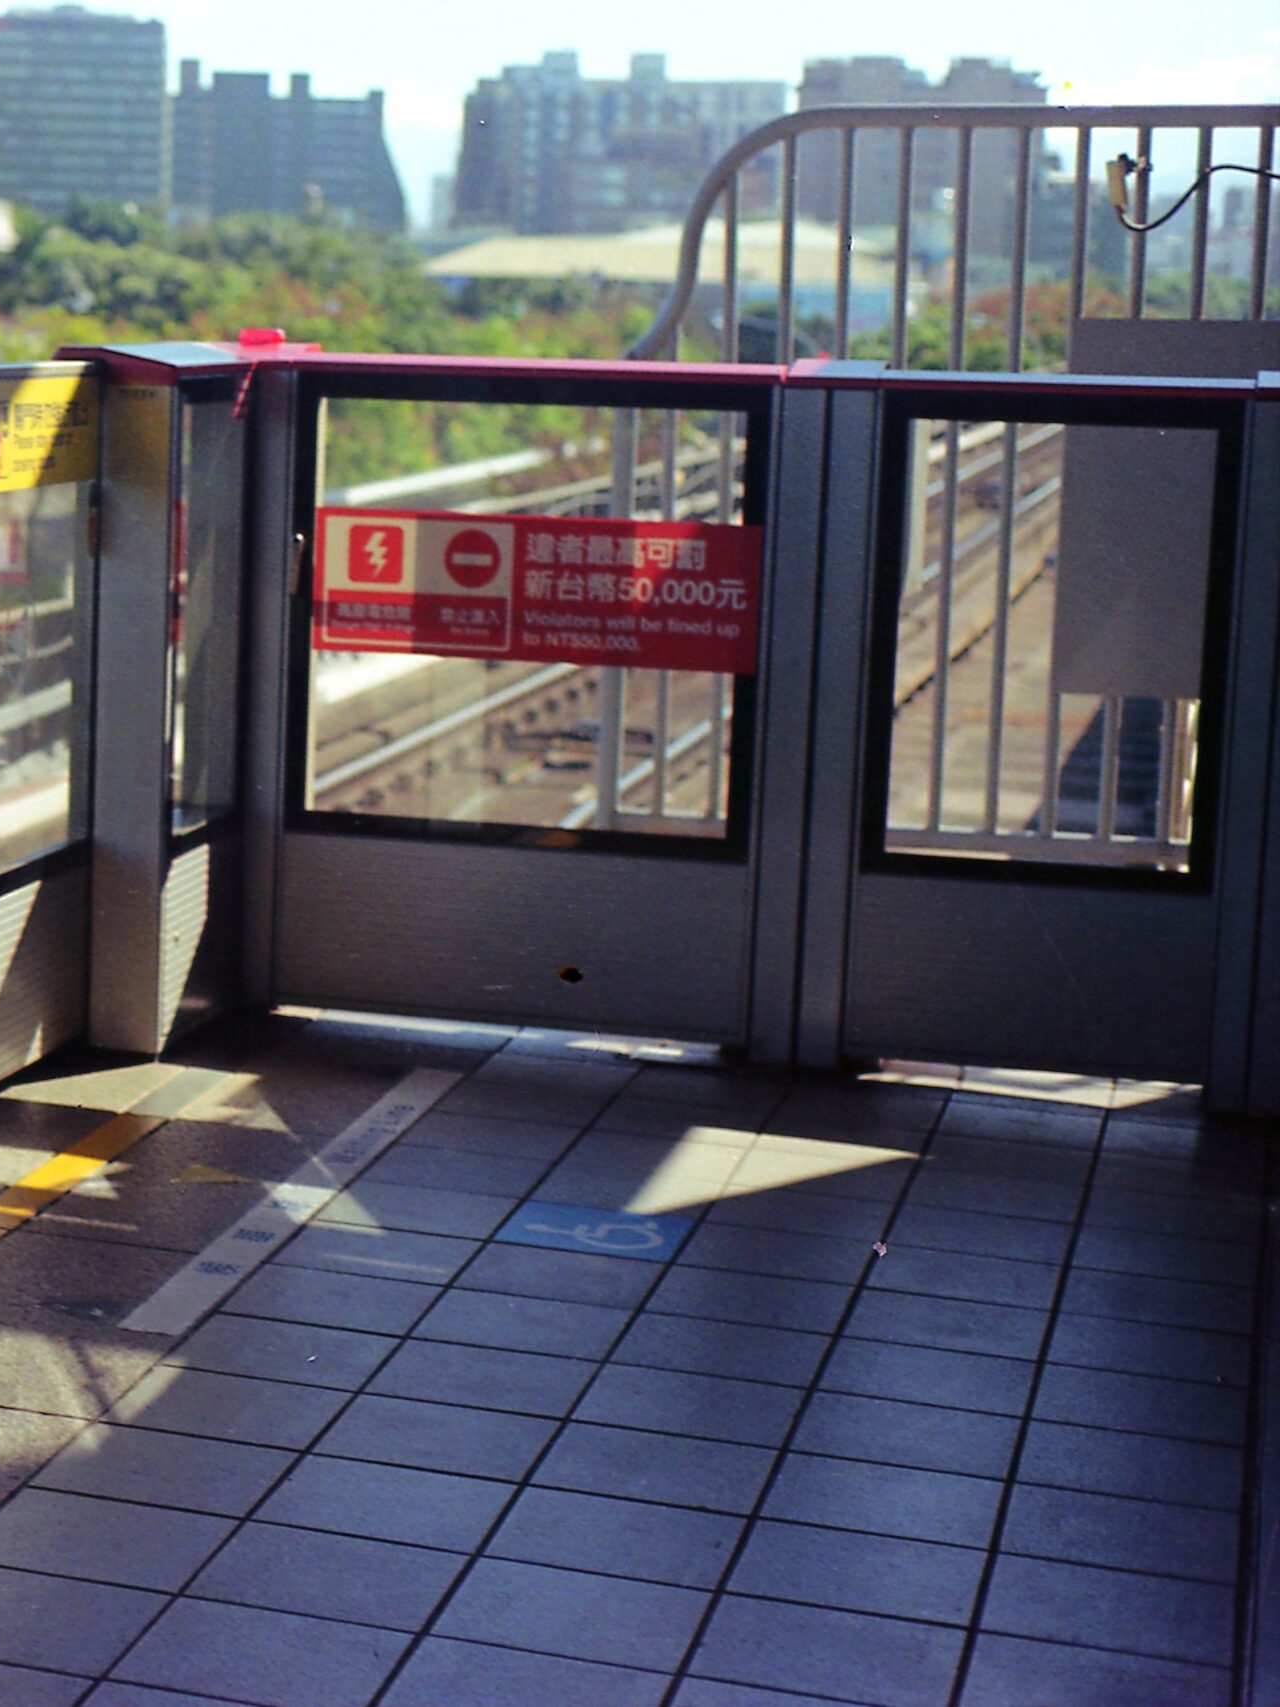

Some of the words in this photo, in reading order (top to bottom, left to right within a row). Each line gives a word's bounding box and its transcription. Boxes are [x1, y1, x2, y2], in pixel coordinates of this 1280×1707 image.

[525, 533, 706, 571] 違者最高可罰
[524, 569, 748, 610] 新台幣50,000元
[521, 631, 540, 646] to
[524, 610, 601, 628] Violators
[606, 615, 635, 631] will
[640, 616, 663, 632] be
[667, 618, 712, 635] fined
[717, 623, 741, 639] up
